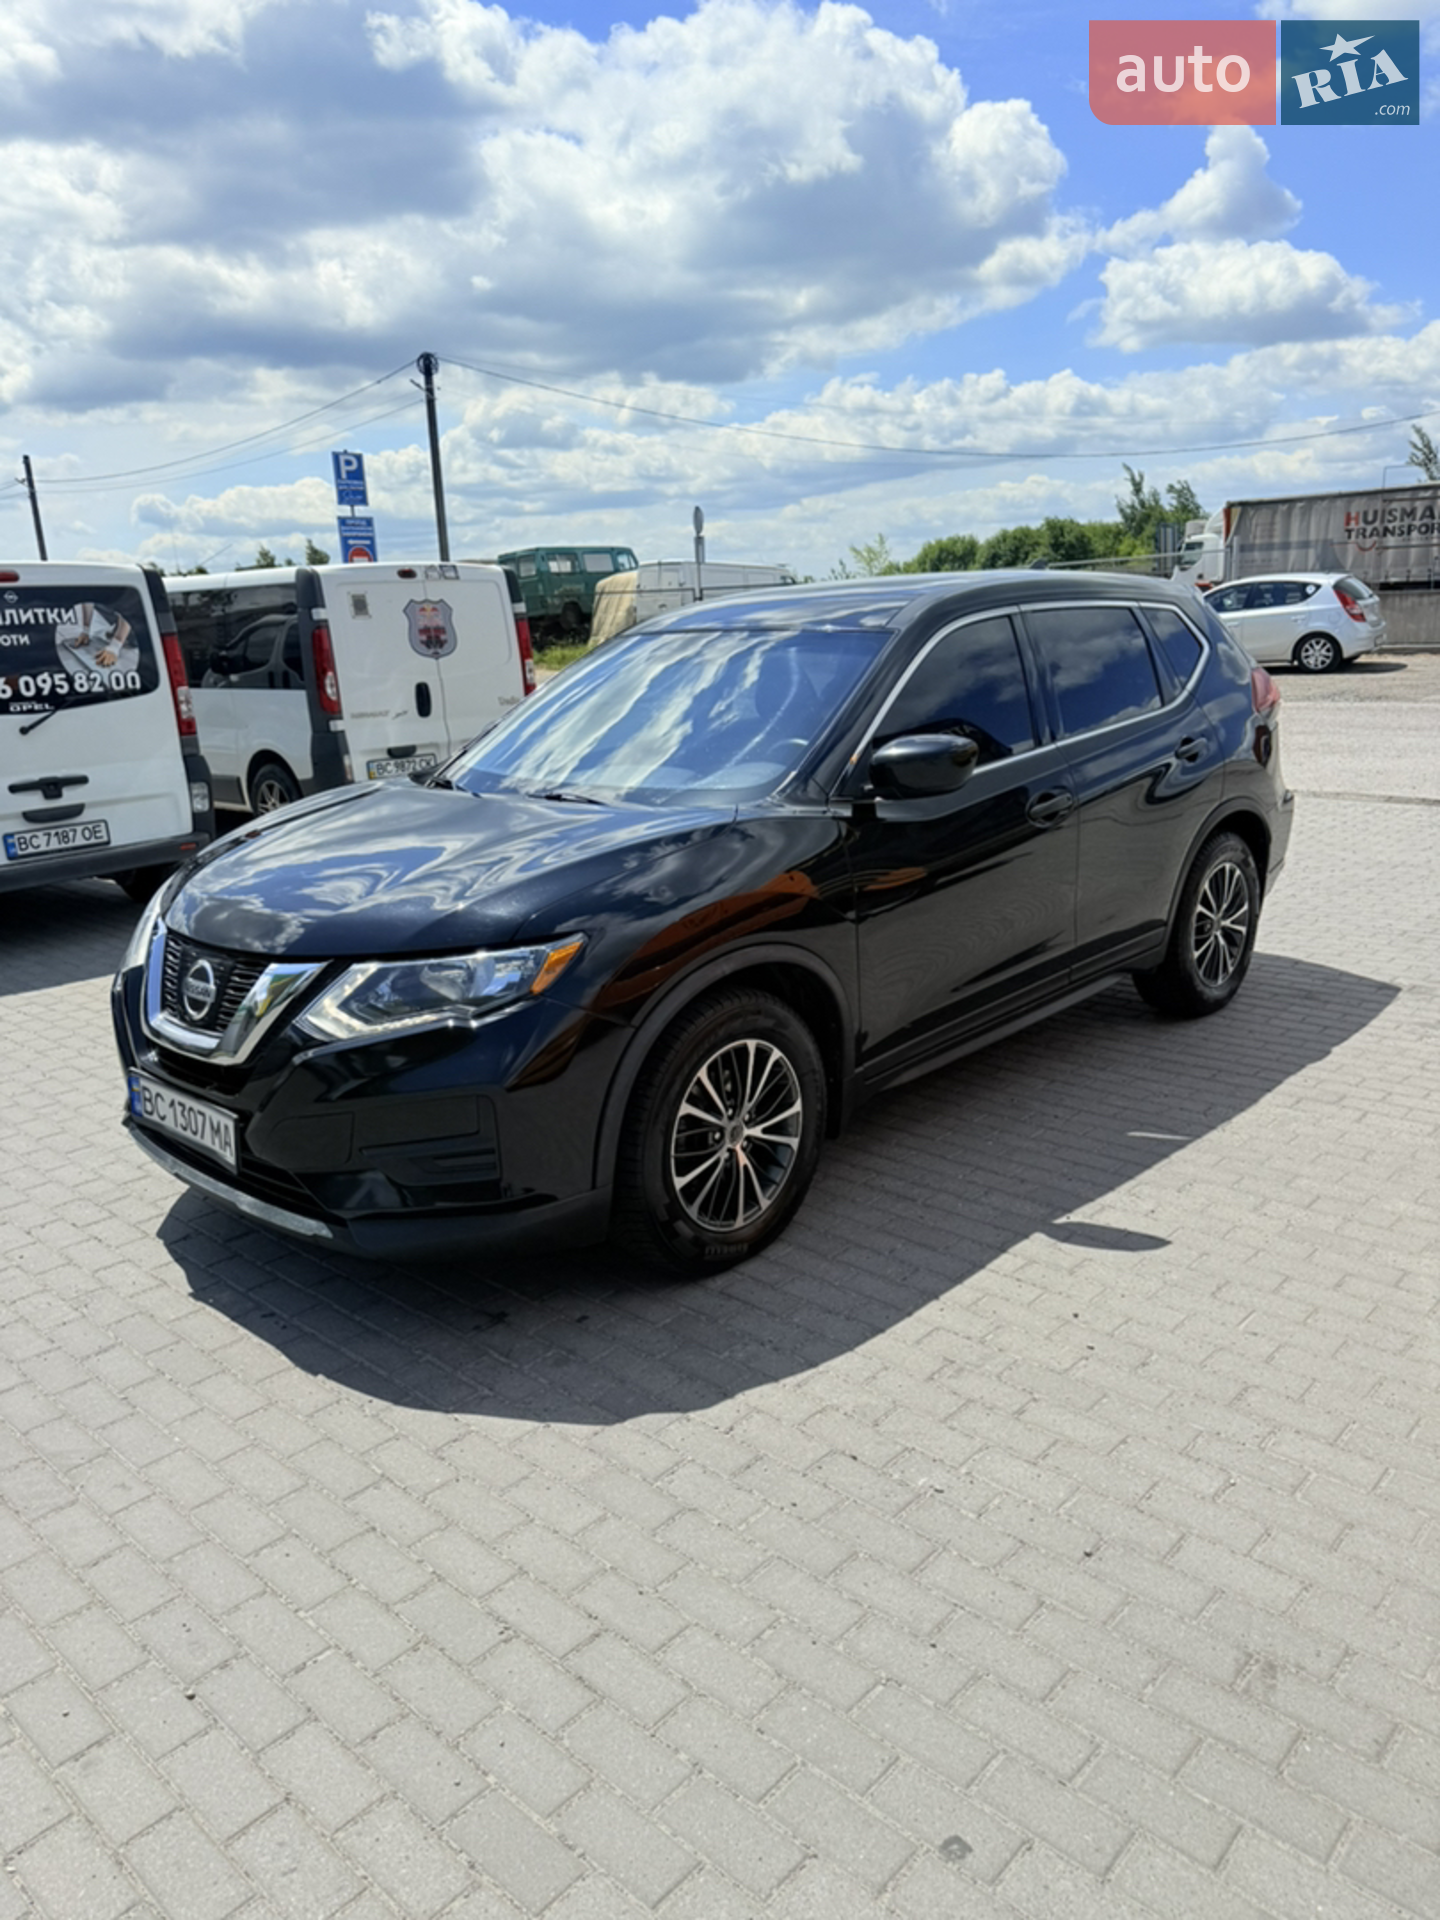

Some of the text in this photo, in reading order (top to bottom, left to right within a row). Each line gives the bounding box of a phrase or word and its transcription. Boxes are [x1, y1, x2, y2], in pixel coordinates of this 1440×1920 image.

[1344, 505, 1440, 527] HUISMA
[0, 607, 76, 626] ЛИТКИ
[18, 671, 69, 697] 095
[74, 671, 104, 693] 82
[110, 671, 141, 690] 00
[9, 702, 55, 712] OPEL
[17, 824, 104, 851] BC 7187 OE
[142, 1086, 234, 1157] BC 1307 MA
